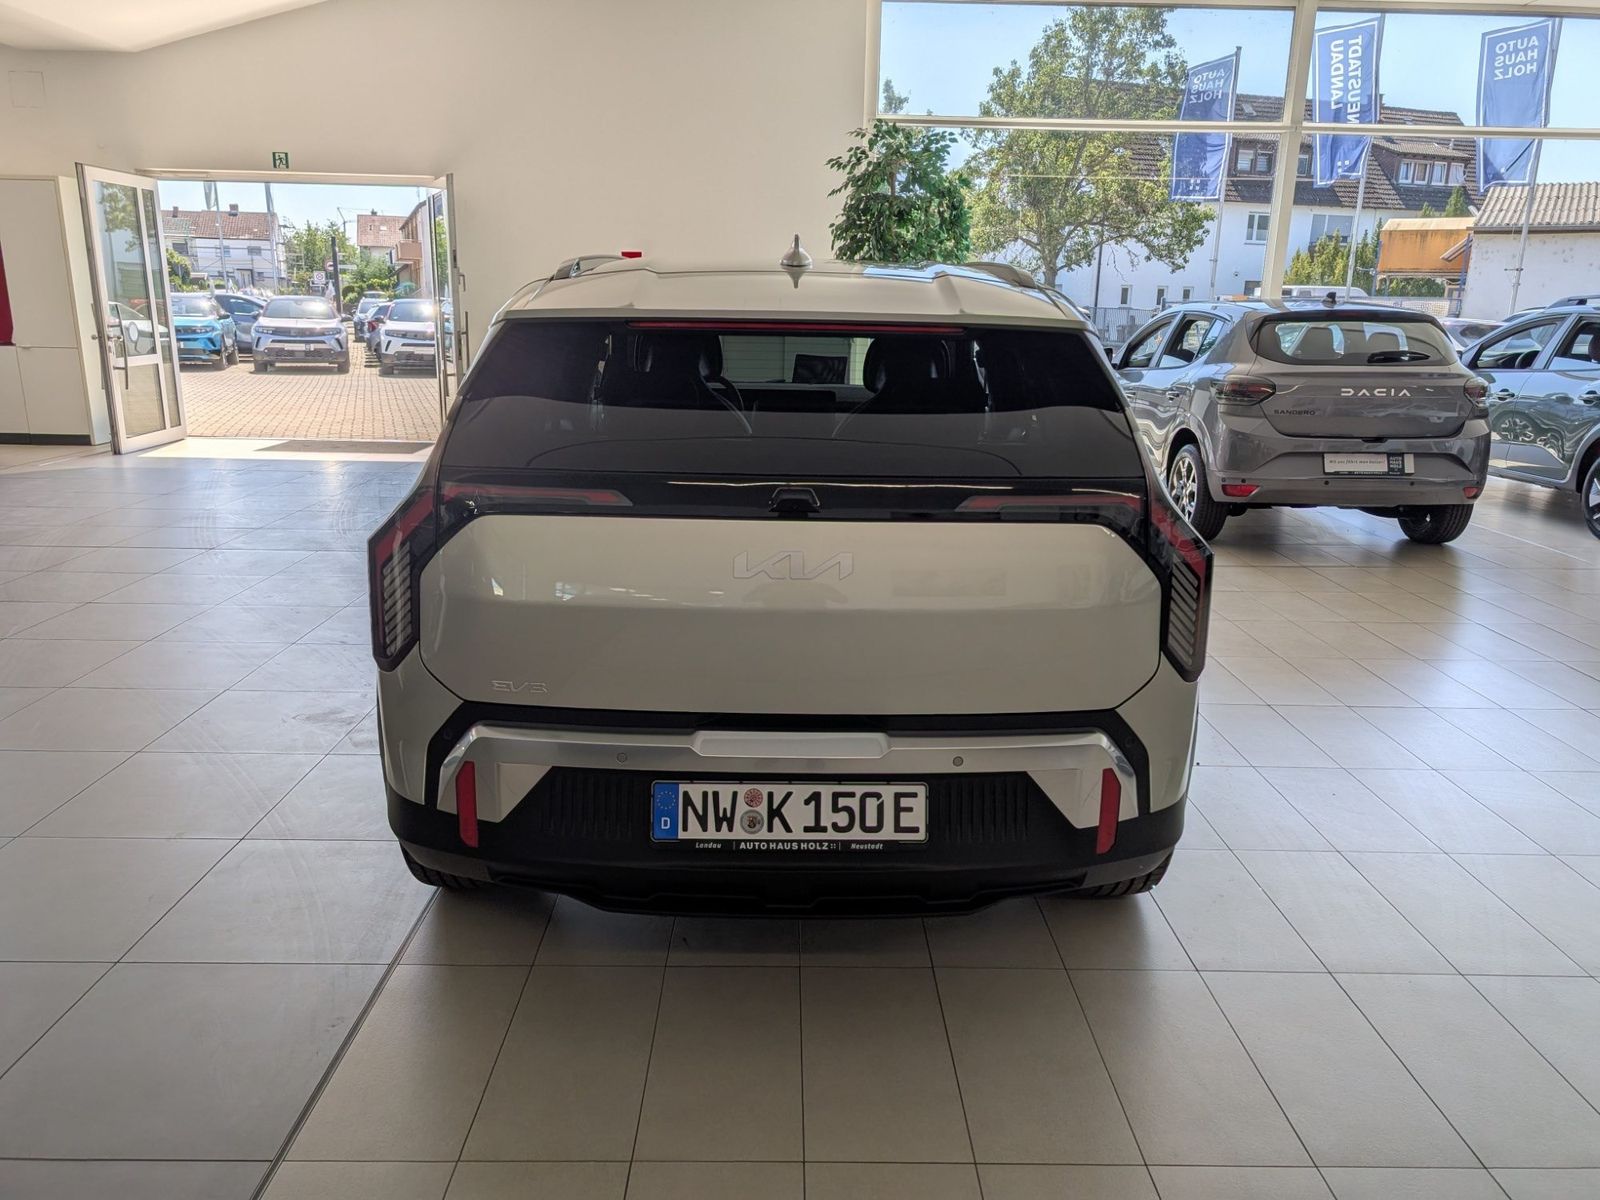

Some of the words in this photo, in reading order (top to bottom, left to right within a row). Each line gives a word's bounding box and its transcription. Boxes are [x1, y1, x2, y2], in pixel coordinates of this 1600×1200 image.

[1340, 388, 1411, 397] DACIA
[733, 550, 854, 580] KIA
[491, 680, 548, 693] EV3
[682, 790, 738, 832] NW
[767, 791, 793, 833] K
[661, 817, 671, 829] D
[739, 842, 767, 850] AUTO
[769, 842, 799, 850] HAUS
[800, 842, 829, 850] HOLZ
